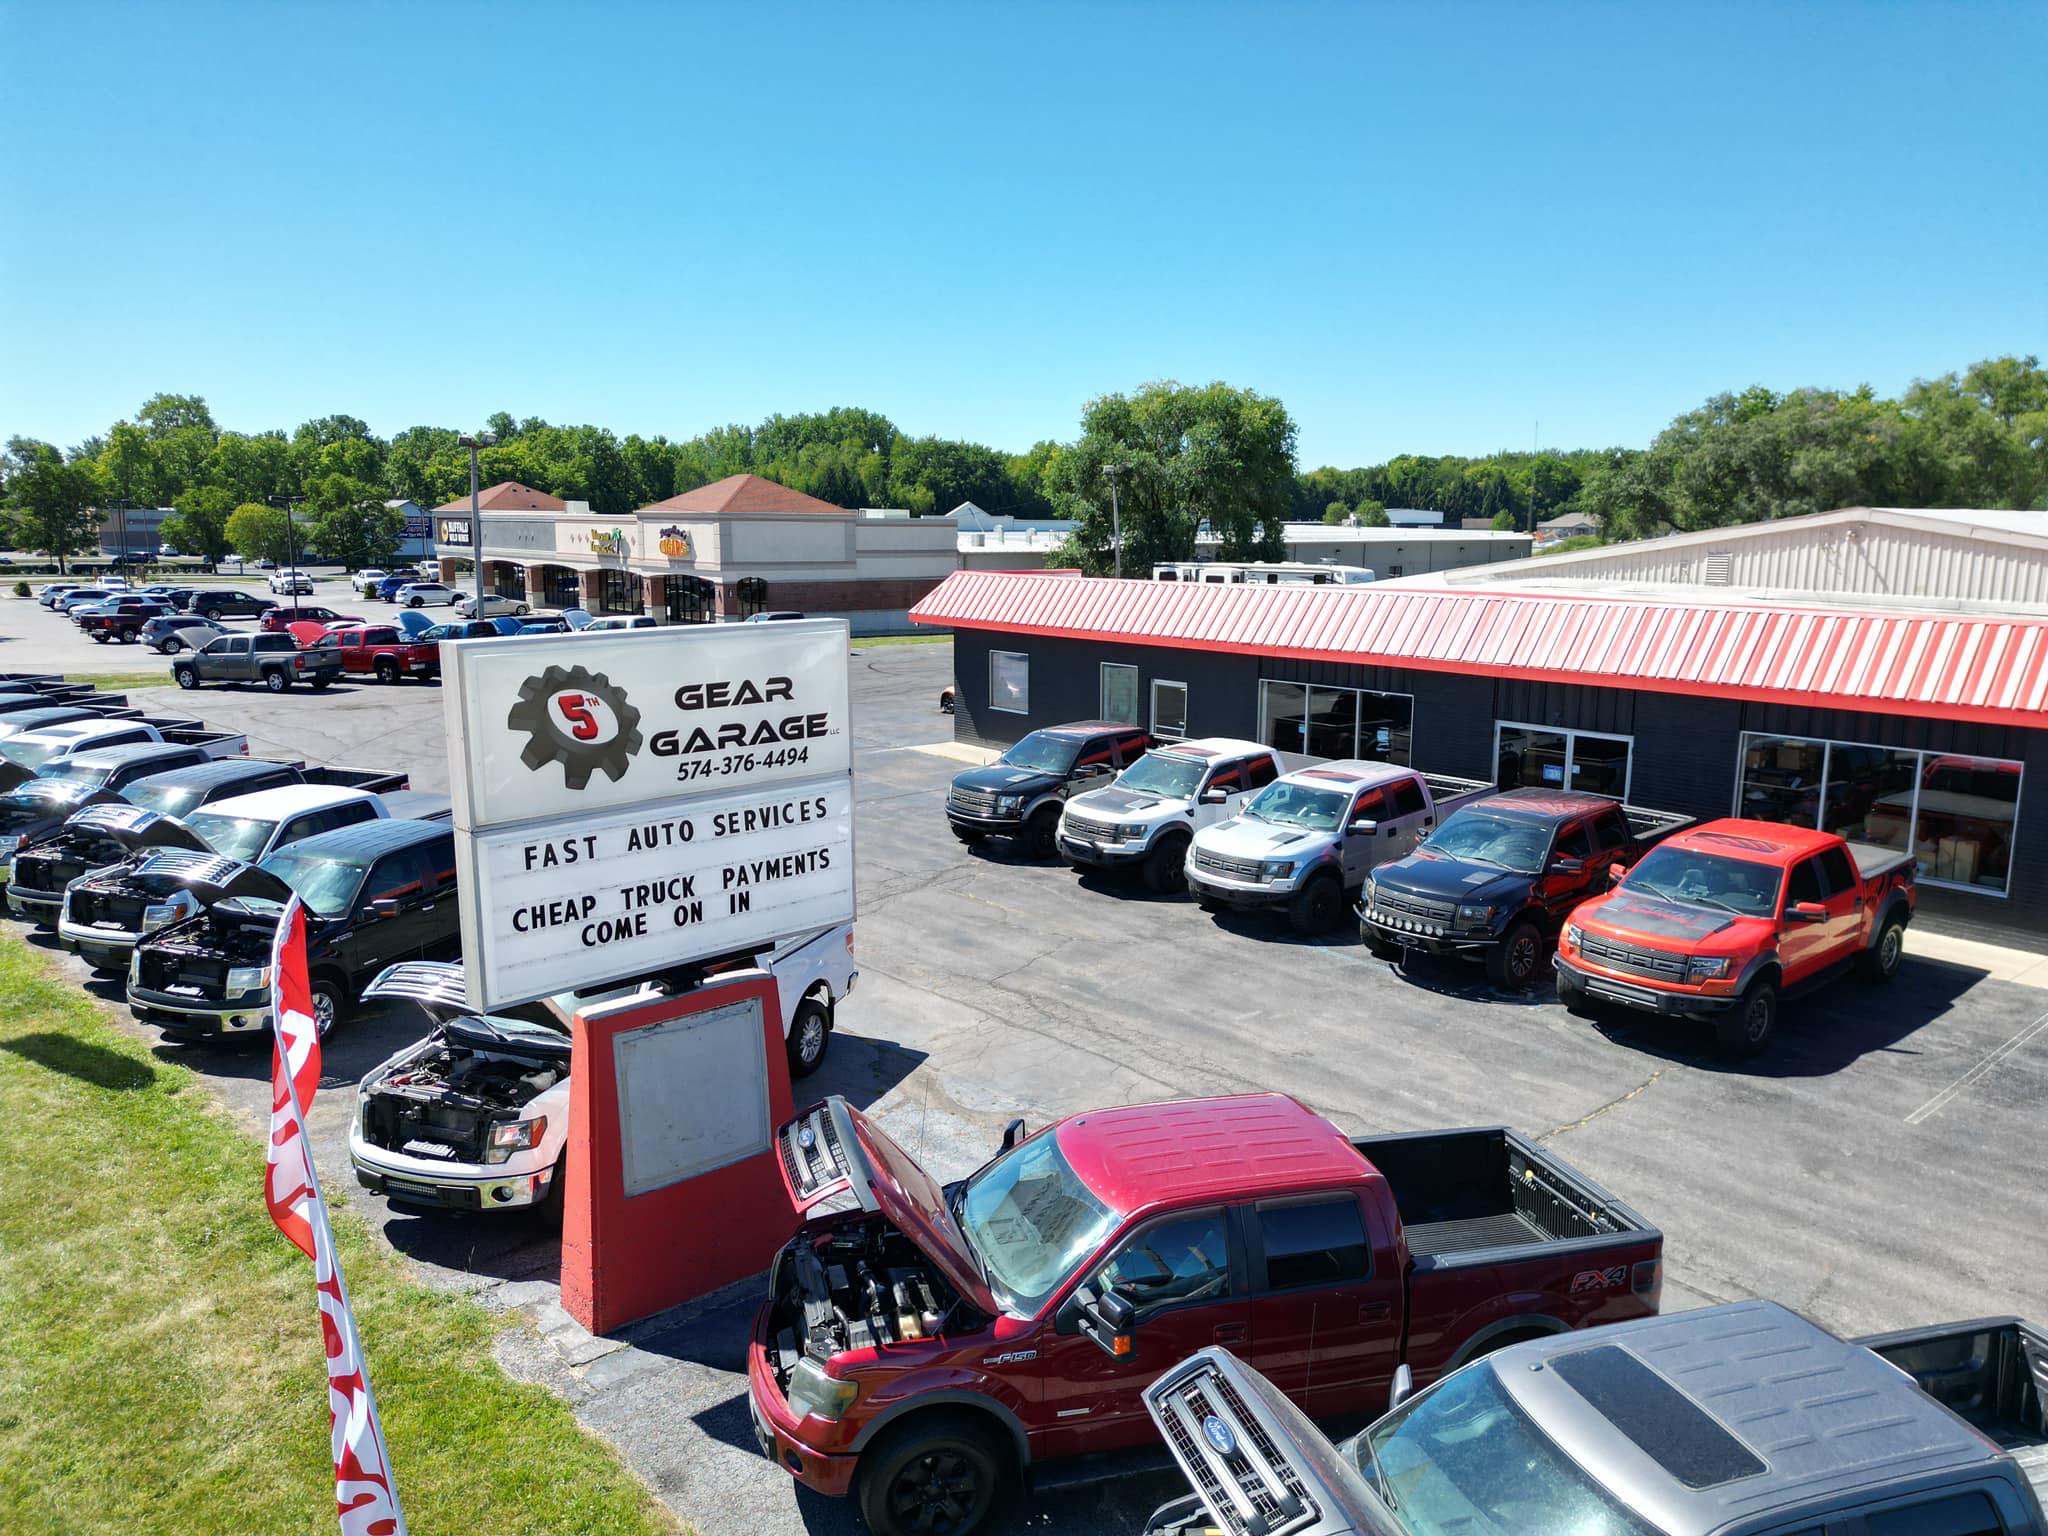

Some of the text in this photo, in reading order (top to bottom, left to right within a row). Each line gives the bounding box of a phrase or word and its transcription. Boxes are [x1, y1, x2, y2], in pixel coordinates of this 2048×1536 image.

[447, 521, 469, 533] BUFFALO
[674, 676, 795, 711] GEAR
[649, 712, 840, 757] GARAGE LLC
[676, 745, 809, 782] 574-376-4494
[524, 797, 827, 870] FAST AUTO SERVICES
[512, 848, 830, 932] CHEAP TRUCK PAYMENTS
[581, 890, 751, 947] COME ON IN
[1583, 939, 1686, 974] FORD
[1571, 1264, 1627, 1289] FX4
